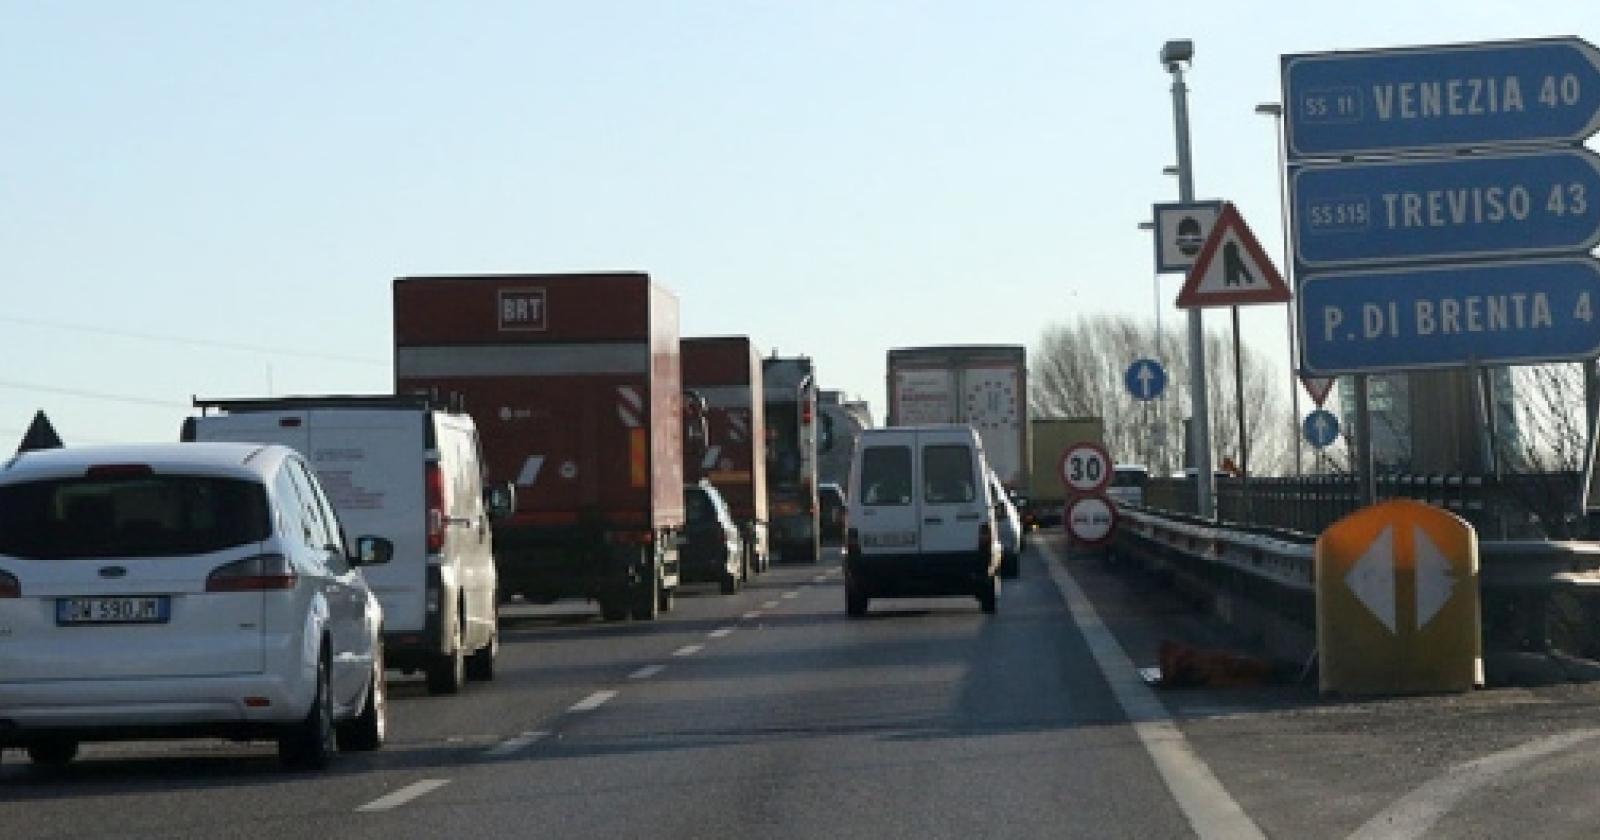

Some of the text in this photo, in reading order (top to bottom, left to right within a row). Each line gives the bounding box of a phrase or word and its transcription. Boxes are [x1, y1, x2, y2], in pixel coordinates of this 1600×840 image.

[1306, 97, 1326, 116] SS
[1373, 74, 1581, 120] VENEZIA 40
[1312, 205, 1333, 225] SS
[1382, 184, 1588, 229] TREVISO 43
[503, 298, 543, 321] BRT
[1416, 291, 1552, 335] BRENTA
[1574, 290, 1593, 321] 4
[1071, 456, 1100, 481] 30
